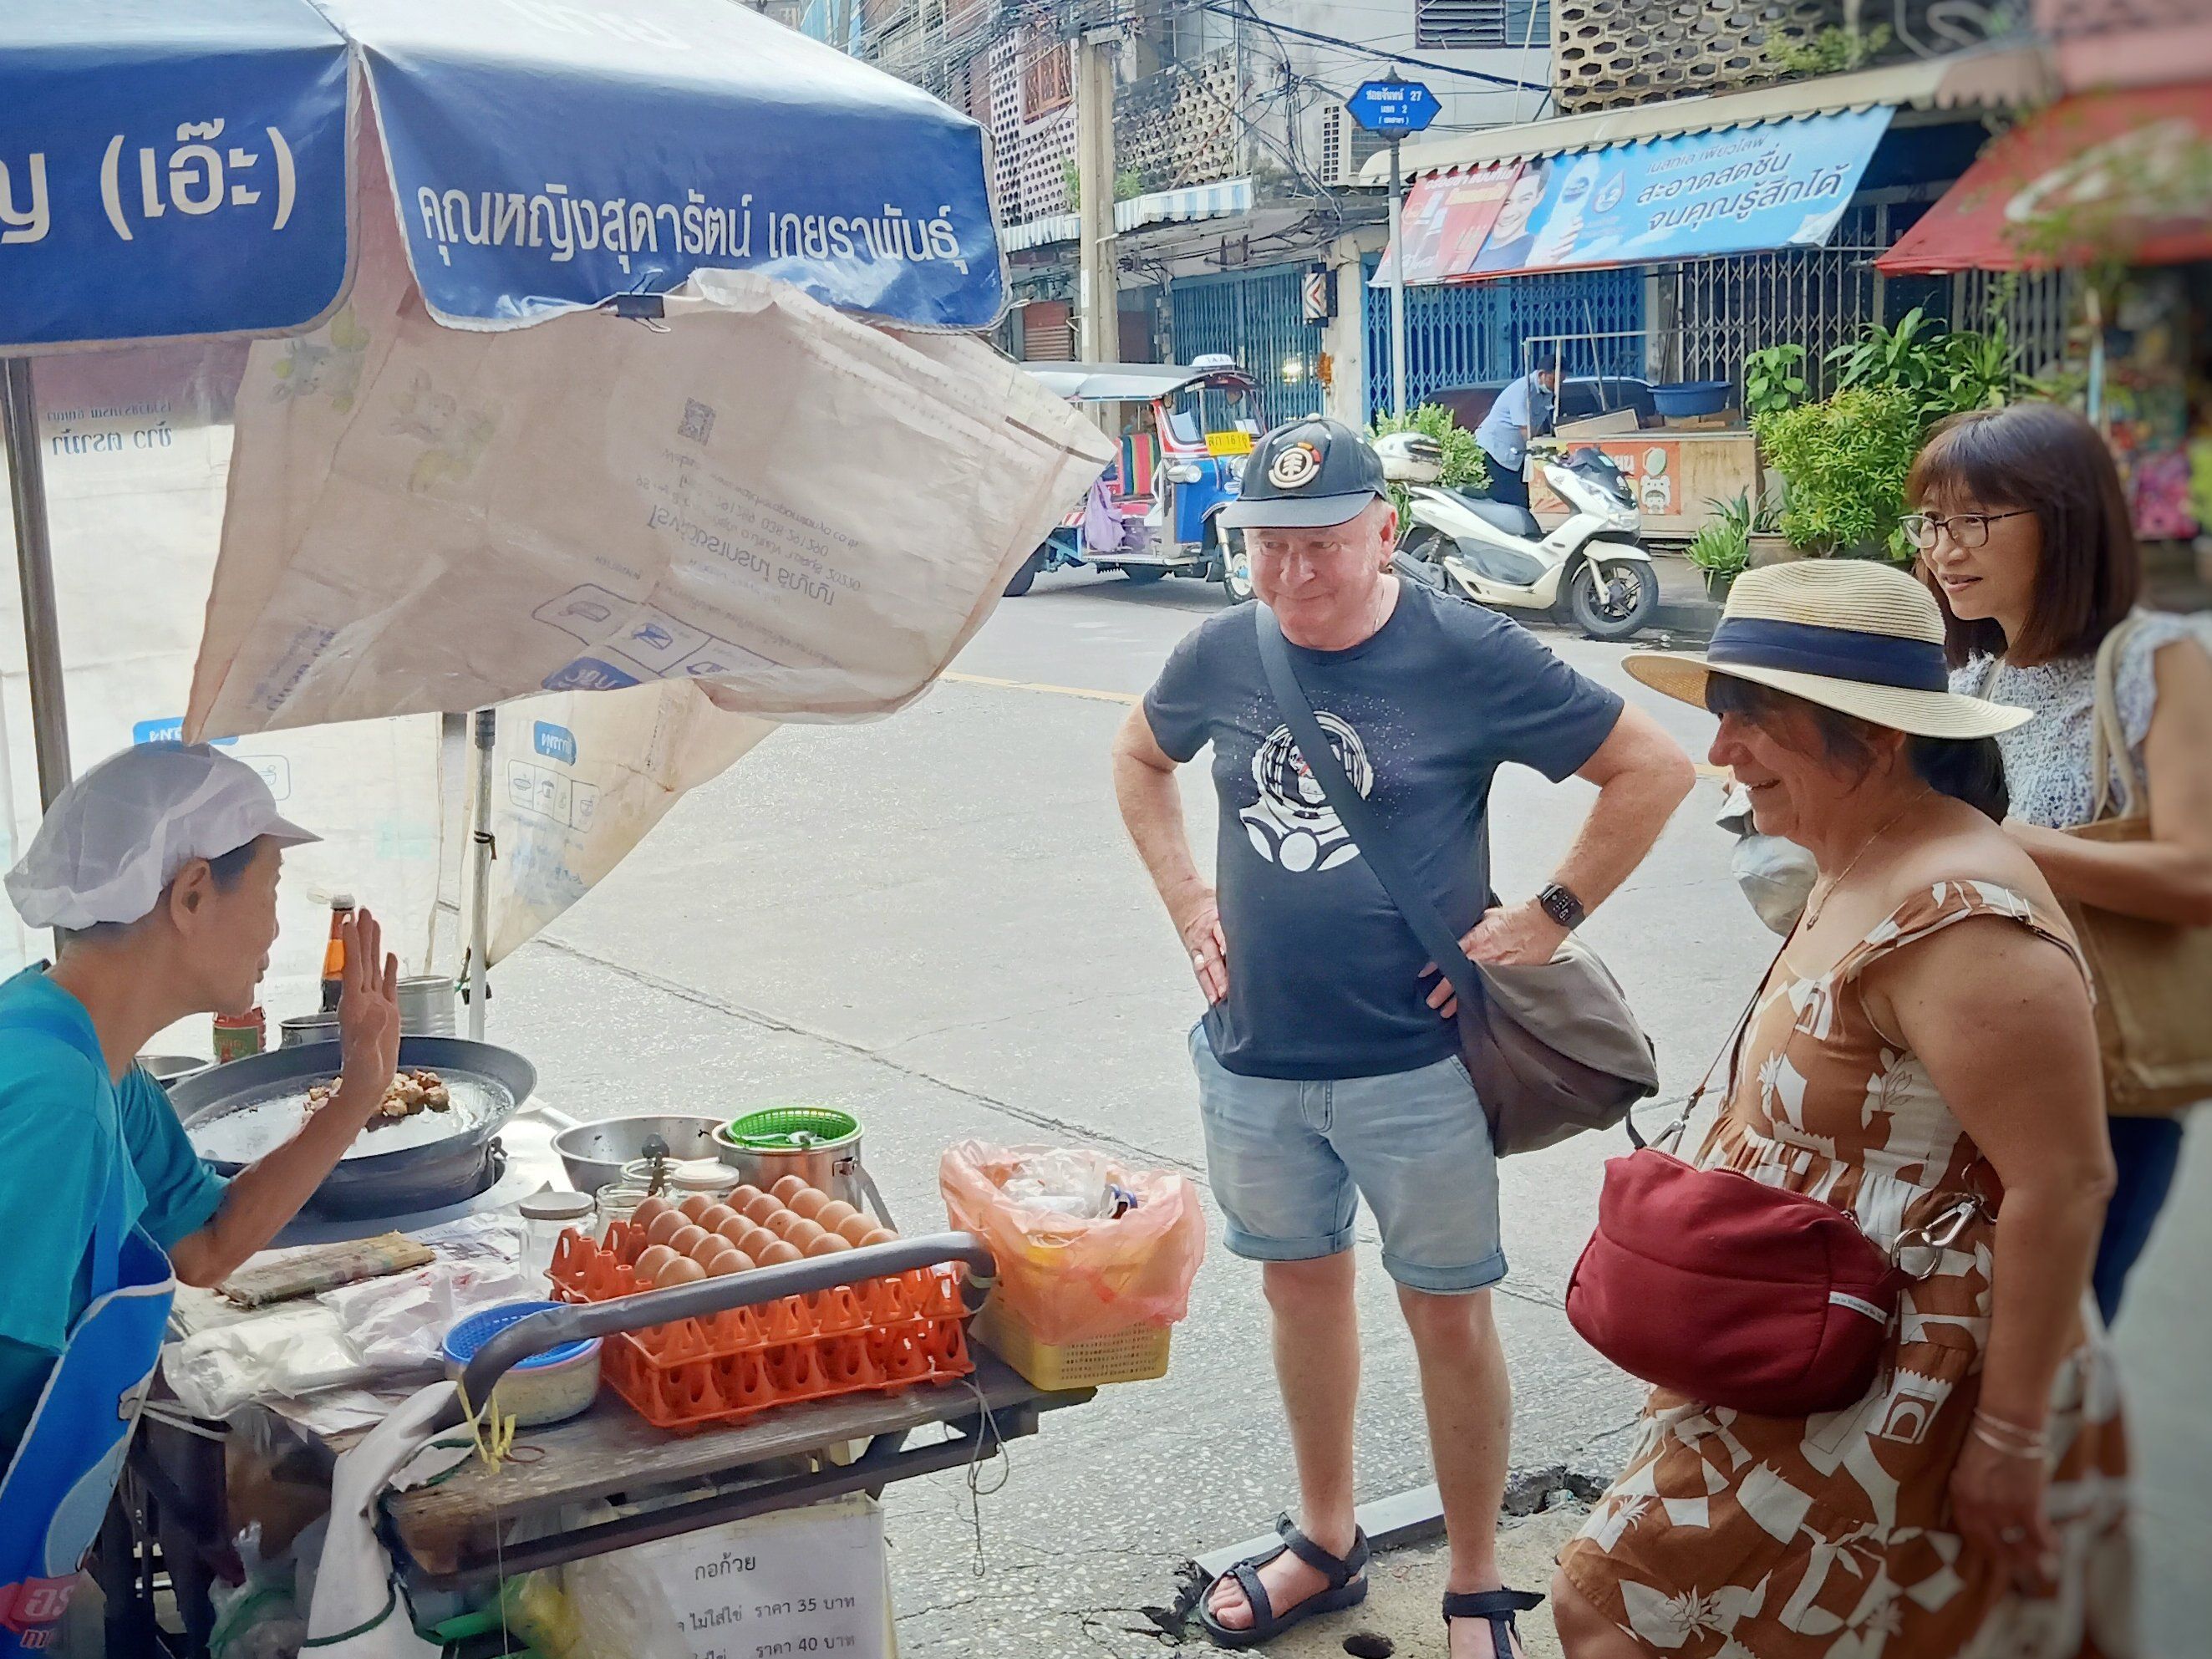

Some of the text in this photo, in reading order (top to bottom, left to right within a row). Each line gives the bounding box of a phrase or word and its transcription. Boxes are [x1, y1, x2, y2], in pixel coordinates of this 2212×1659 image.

[1410, 90, 1422, 101] 27
[1401, 104, 1408, 114] 2
[1636, 143, 1792, 204] สะอาดสดชื่น
[1649, 162, 1850, 230] จนคุณรู้สึกได้
[417, 182, 753, 274] คุณหญิงสุดารัตน์
[755, 1601, 791, 1619] ราคา
[796, 1597, 817, 1612] 35
[823, 1595, 856, 1611] บาท
[755, 1634, 856, 1659] ราคา 40 บาท
